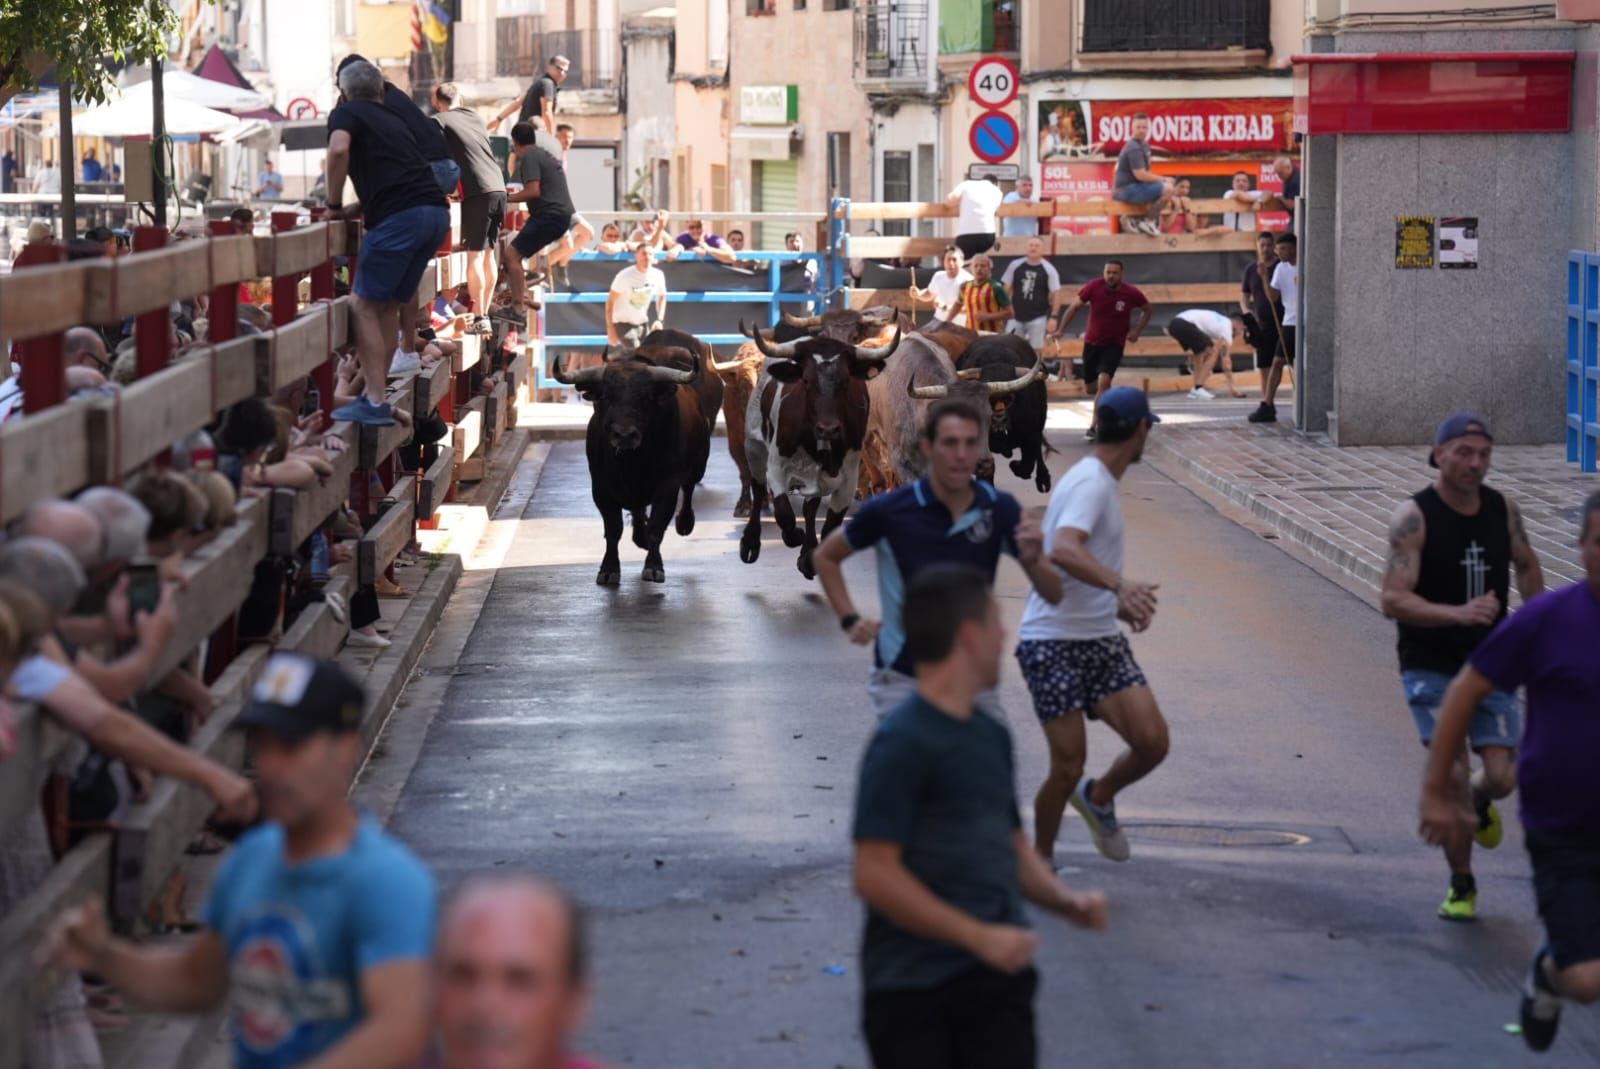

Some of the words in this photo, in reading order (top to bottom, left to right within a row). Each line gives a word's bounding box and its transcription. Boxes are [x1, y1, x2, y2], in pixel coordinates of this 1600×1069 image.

[979, 74, 1009, 92] 40
[1099, 116, 1133, 142] SOL
[1208, 115, 1274, 142] KEBAB
[1044, 166, 1072, 179] SOL
[1044, 181, 1075, 190] DONER
[1077, 181, 1109, 190] KEBAB
